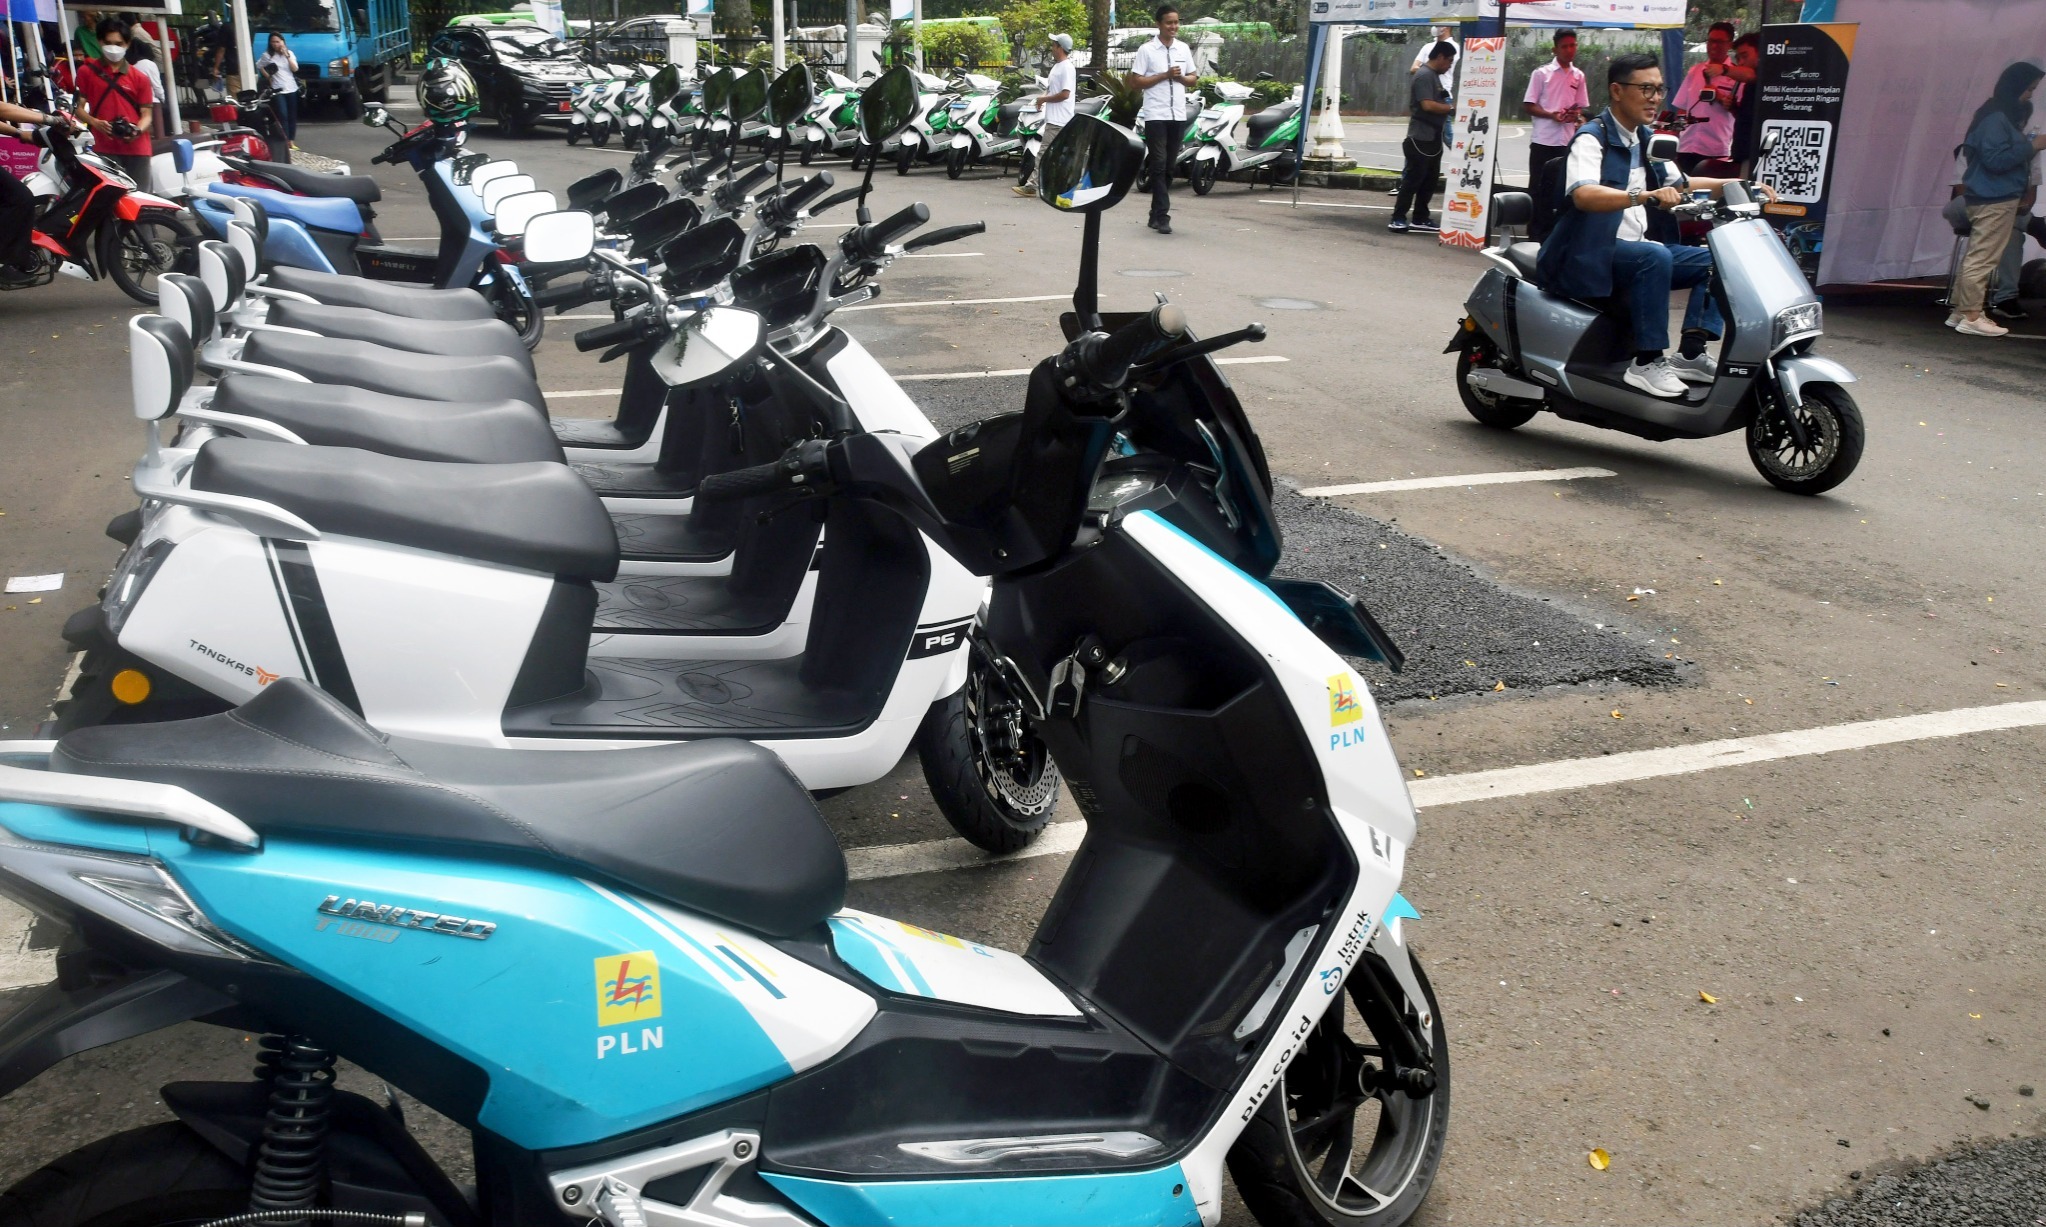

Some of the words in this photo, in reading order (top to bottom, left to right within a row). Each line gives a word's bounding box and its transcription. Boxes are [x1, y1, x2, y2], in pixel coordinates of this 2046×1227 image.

[1766, 44, 1786, 54] BSI
[1761, 95, 1784, 103] dengan
[1784, 95, 1815, 103] Angsuran
[1815, 95, 1840, 104] Ringan
[1816, 86, 1841, 95] Impian
[1783, 104, 1812, 112] Sekarang
[1729, 367, 1749, 375] P6
[924, 632, 956, 650] P6
[189, 639, 255, 676] TANGKAS
[1330, 726, 1365, 751] PLN
[313, 914, 401, 944] T1800
[317, 894, 497, 940] UNITED
[1344, 915, 1372, 967] pintar
[597, 1025, 664, 1060] PLN
[1241, 1014, 1312, 1122] pln.co.id
